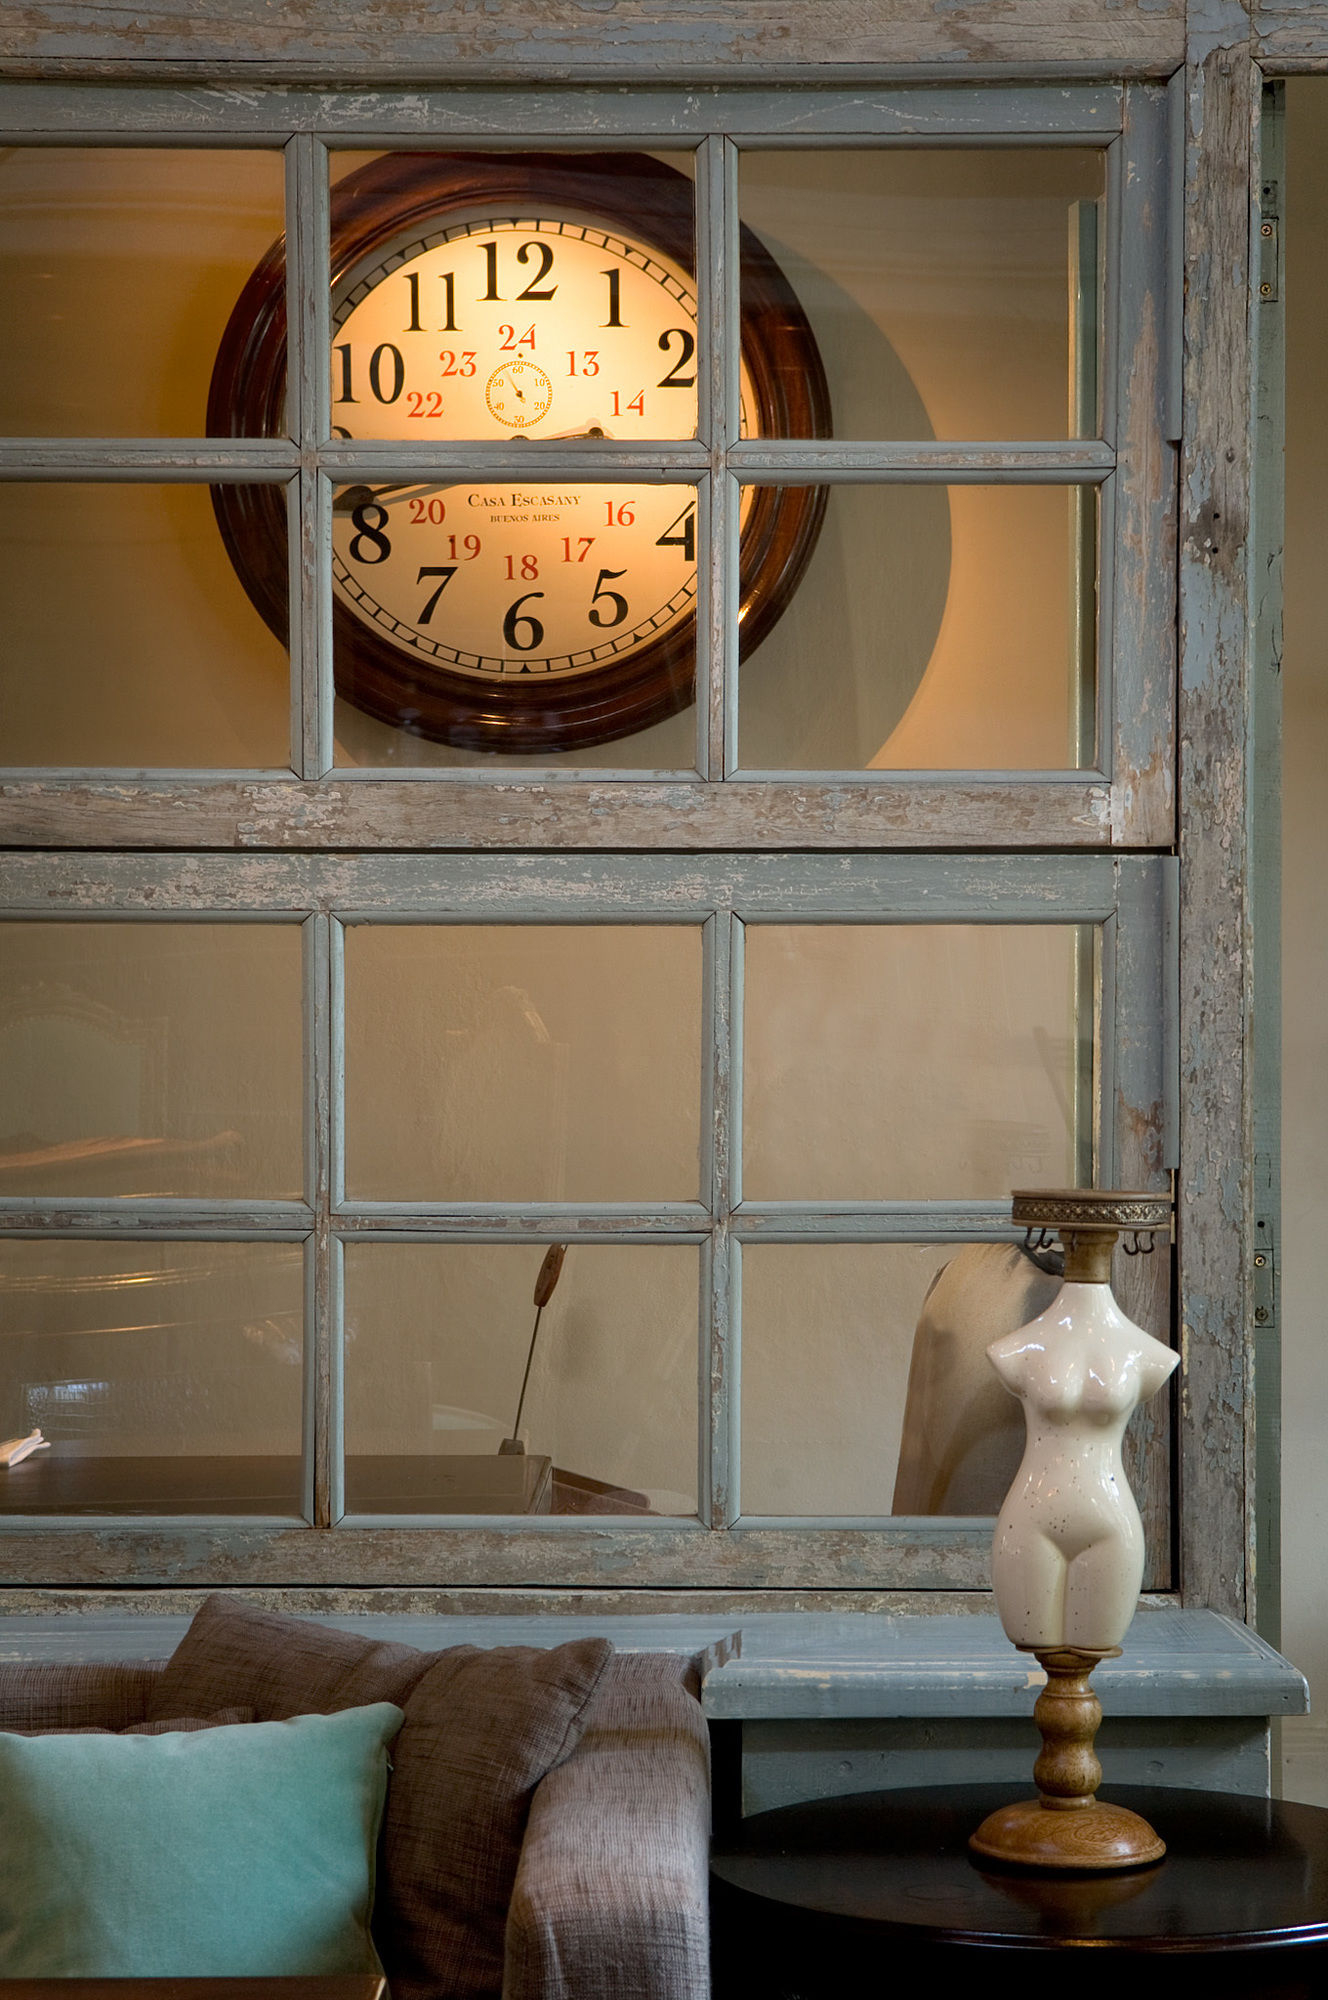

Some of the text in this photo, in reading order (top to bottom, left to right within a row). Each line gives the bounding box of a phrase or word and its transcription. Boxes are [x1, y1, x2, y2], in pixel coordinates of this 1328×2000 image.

[476, 241, 558, 301] 12
[403, 271, 462, 331] 11
[599, 268, 629, 328] 1
[498, 323, 536, 350] 24
[439, 351, 476, 376] 23
[565, 351, 600, 376] 13
[657, 328, 696, 387] 2
[333, 343, 405, 404] 10
[492, 378, 504, 387] 50
[535, 378, 545, 386] 10
[406, 392, 443, 418] 22
[534, 402, 545, 410] 20
[610, 389, 644, 416] 14
[409, 499, 445, 525] 20
[490, 513, 560, 523] BUENOS AIRES
[604, 501, 635, 526] 16
[349, 503, 391, 564] 8
[655, 500, 696, 561] 4
[447, 535, 481, 560] 19
[561, 537, 596, 562] 17
[504, 555, 539, 580] 18
[416, 567, 458, 624] 7
[588, 569, 628, 627] 5
[503, 592, 544, 651] 6
